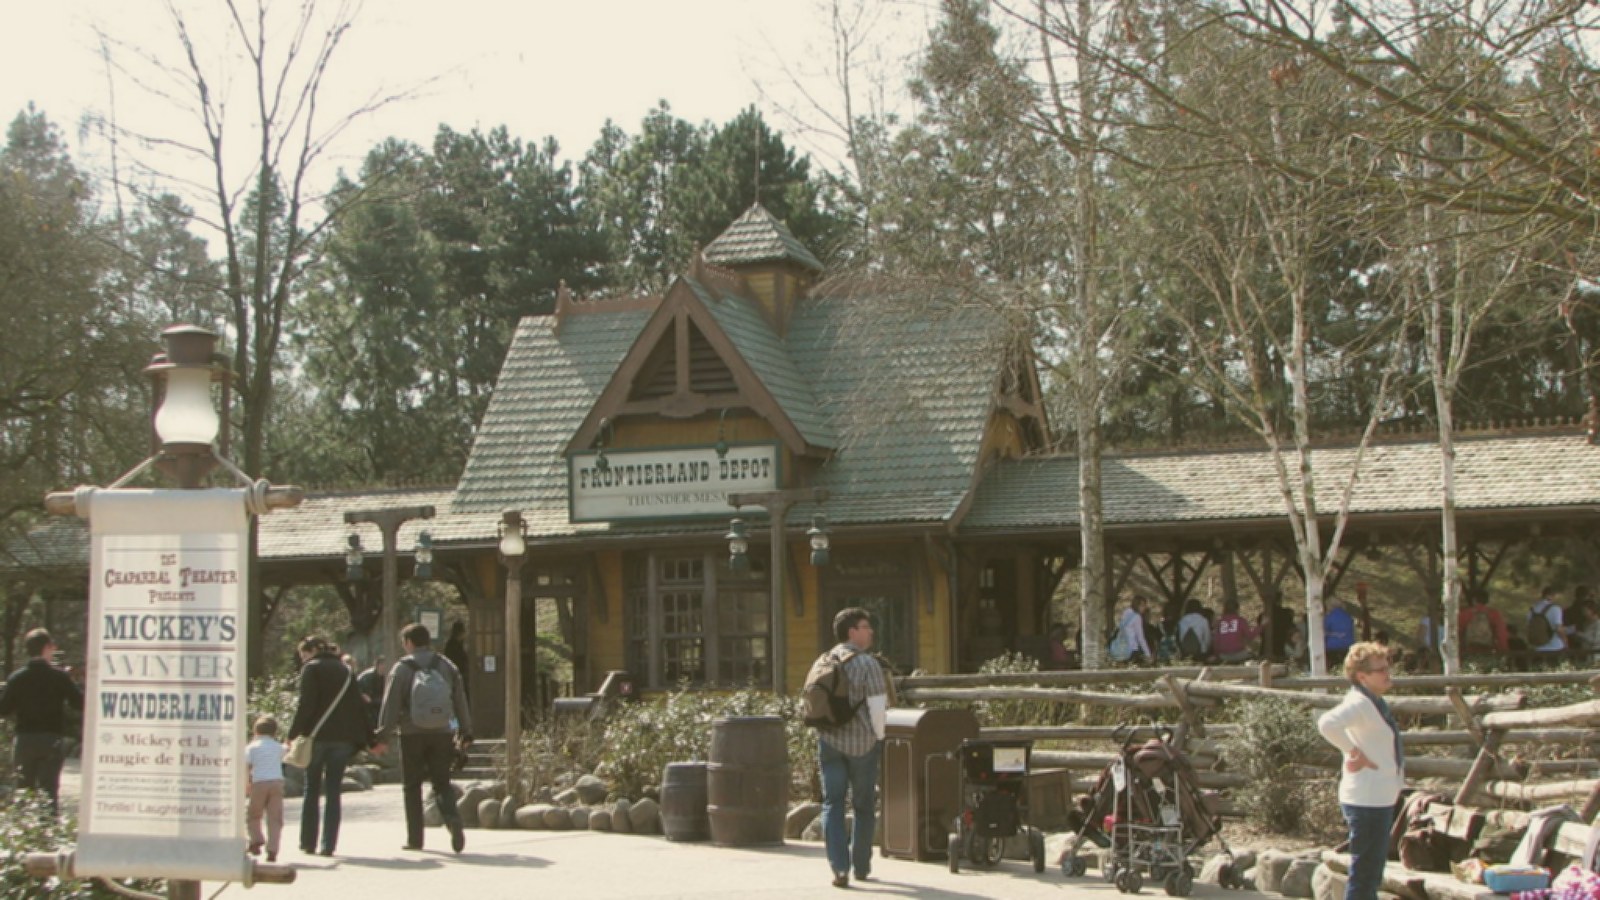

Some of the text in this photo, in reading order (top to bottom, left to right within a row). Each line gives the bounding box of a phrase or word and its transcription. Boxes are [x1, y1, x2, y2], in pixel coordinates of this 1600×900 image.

[580, 457, 770, 489] FRONTIERLAND DEPOT
[626, 492, 692, 506] THUNDER
[179, 566, 238, 588] THEATER
[103, 614, 236, 642] MICKEY'S
[1220, 620, 1238, 634] 23
[103, 654, 234, 678] WINTER
[100, 692, 235, 722] WONDERLAND
[122, 733, 210, 749] Mickey et la
[98, 752, 232, 768] magie de l'hiver
[137, 801, 194, 816] Laughter!
